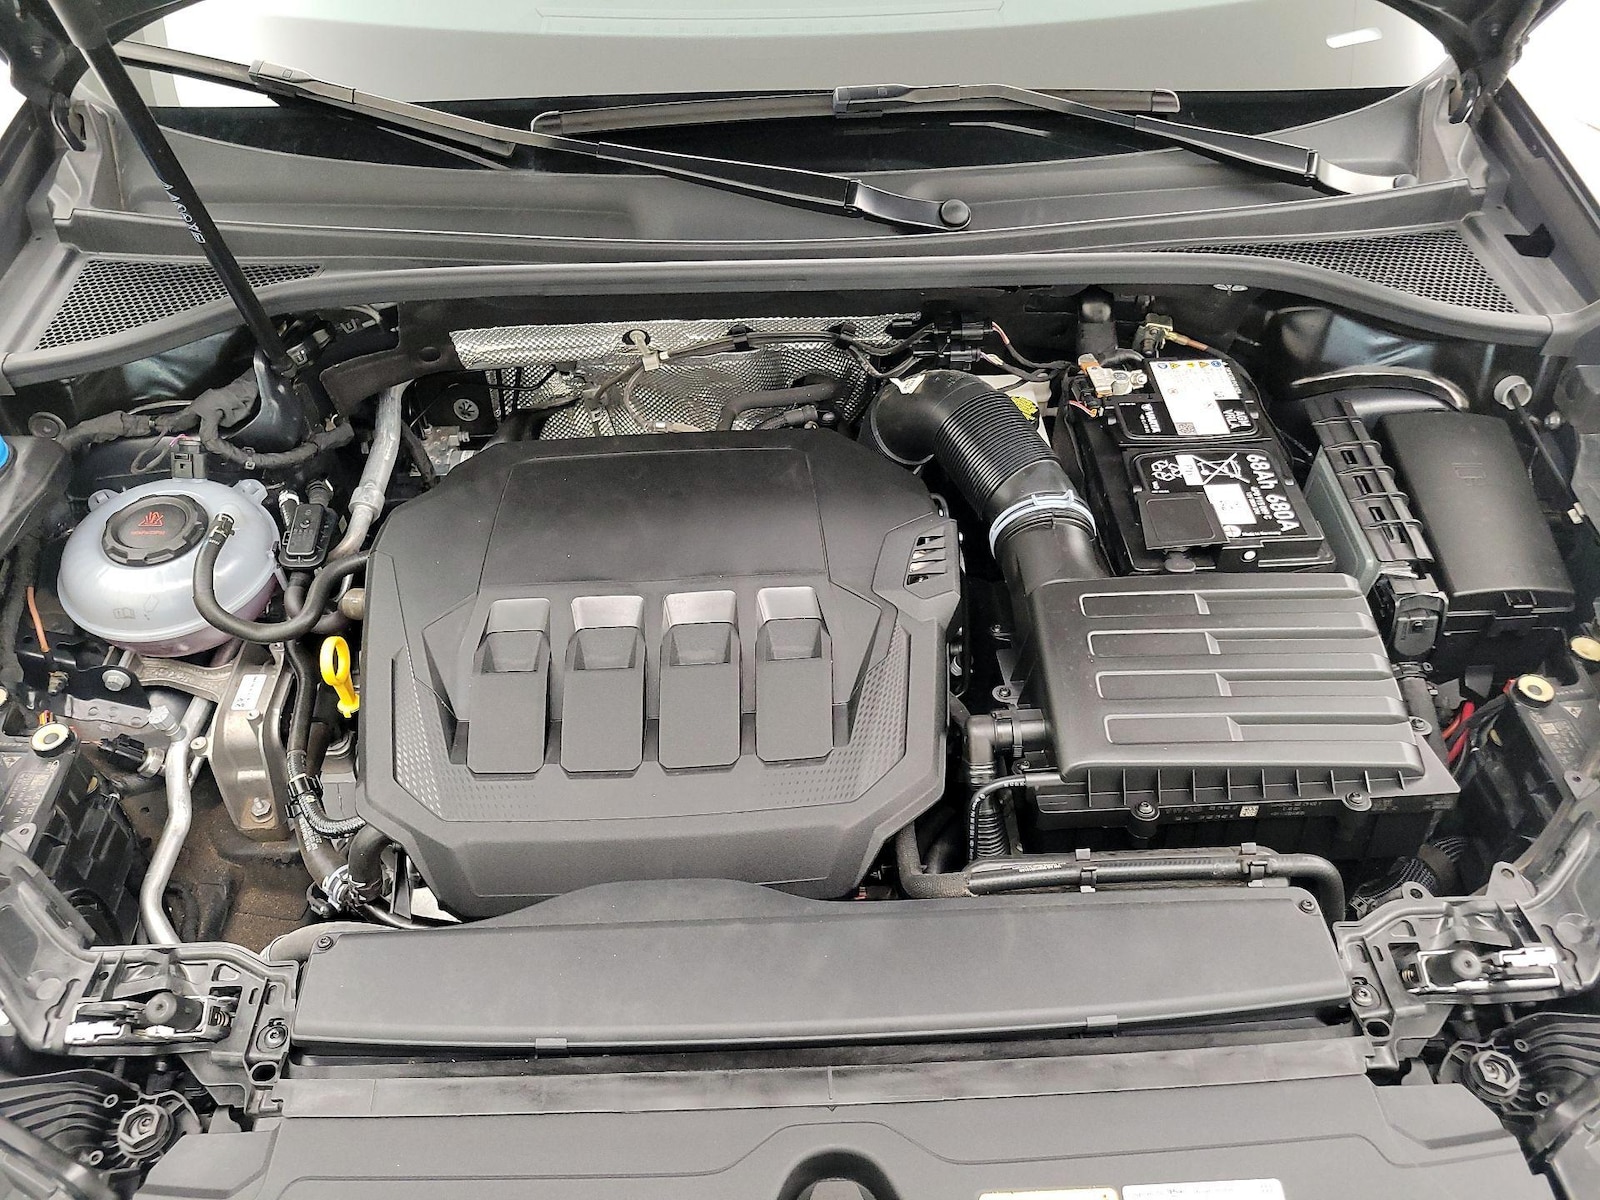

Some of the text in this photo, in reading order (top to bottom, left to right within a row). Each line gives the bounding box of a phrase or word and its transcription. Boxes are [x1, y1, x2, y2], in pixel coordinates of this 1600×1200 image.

[1145, 408, 1161, 433] VARTA
[1223, 409, 1239, 429] VRLA
[1236, 410, 1251, 427] AGM
[1246, 454, 1278, 489] 68Ah
[1265, 494, 1300, 532] 680A
